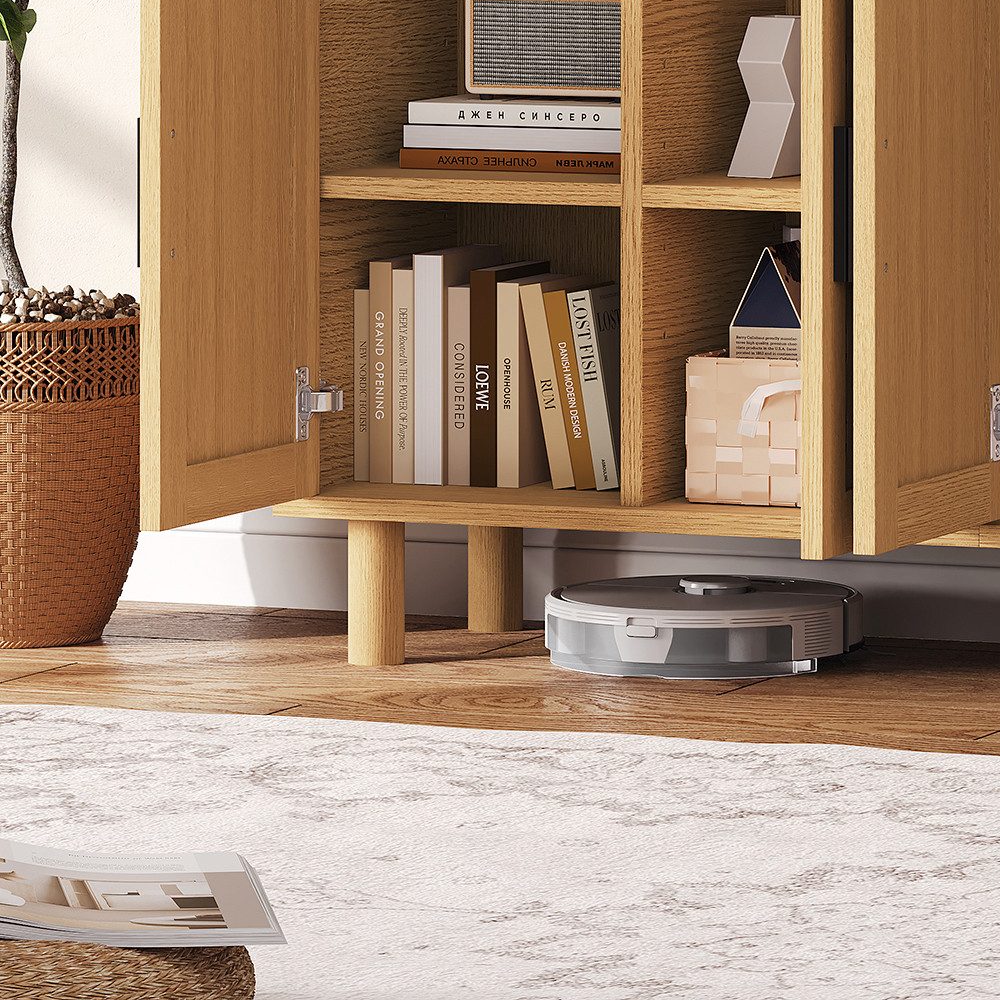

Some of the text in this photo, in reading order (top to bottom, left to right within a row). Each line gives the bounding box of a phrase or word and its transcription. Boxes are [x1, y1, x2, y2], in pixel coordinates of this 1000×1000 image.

[458, 110, 601, 122] ДЖЕН СИНСЕРО
[398, 307, 408, 335] DEEPLY
[359, 341, 367, 360] NEW
[572, 296, 598, 382] LOST FISH
[375, 311, 385, 420] GRAND OPENING
[398, 358, 408, 367] IN
[398, 368, 408, 383] THE
[359, 363, 367, 399] NORDIC
[453, 342, 466, 430] CONSIDERED
[475, 364, 490, 411] LOEWE
[503, 357, 511, 410] OPENHOUSE
[557, 341, 582, 440] DANISH MODERN DESIGN
[398, 384, 408, 412] POWER
[398, 413, 408, 424] OF
